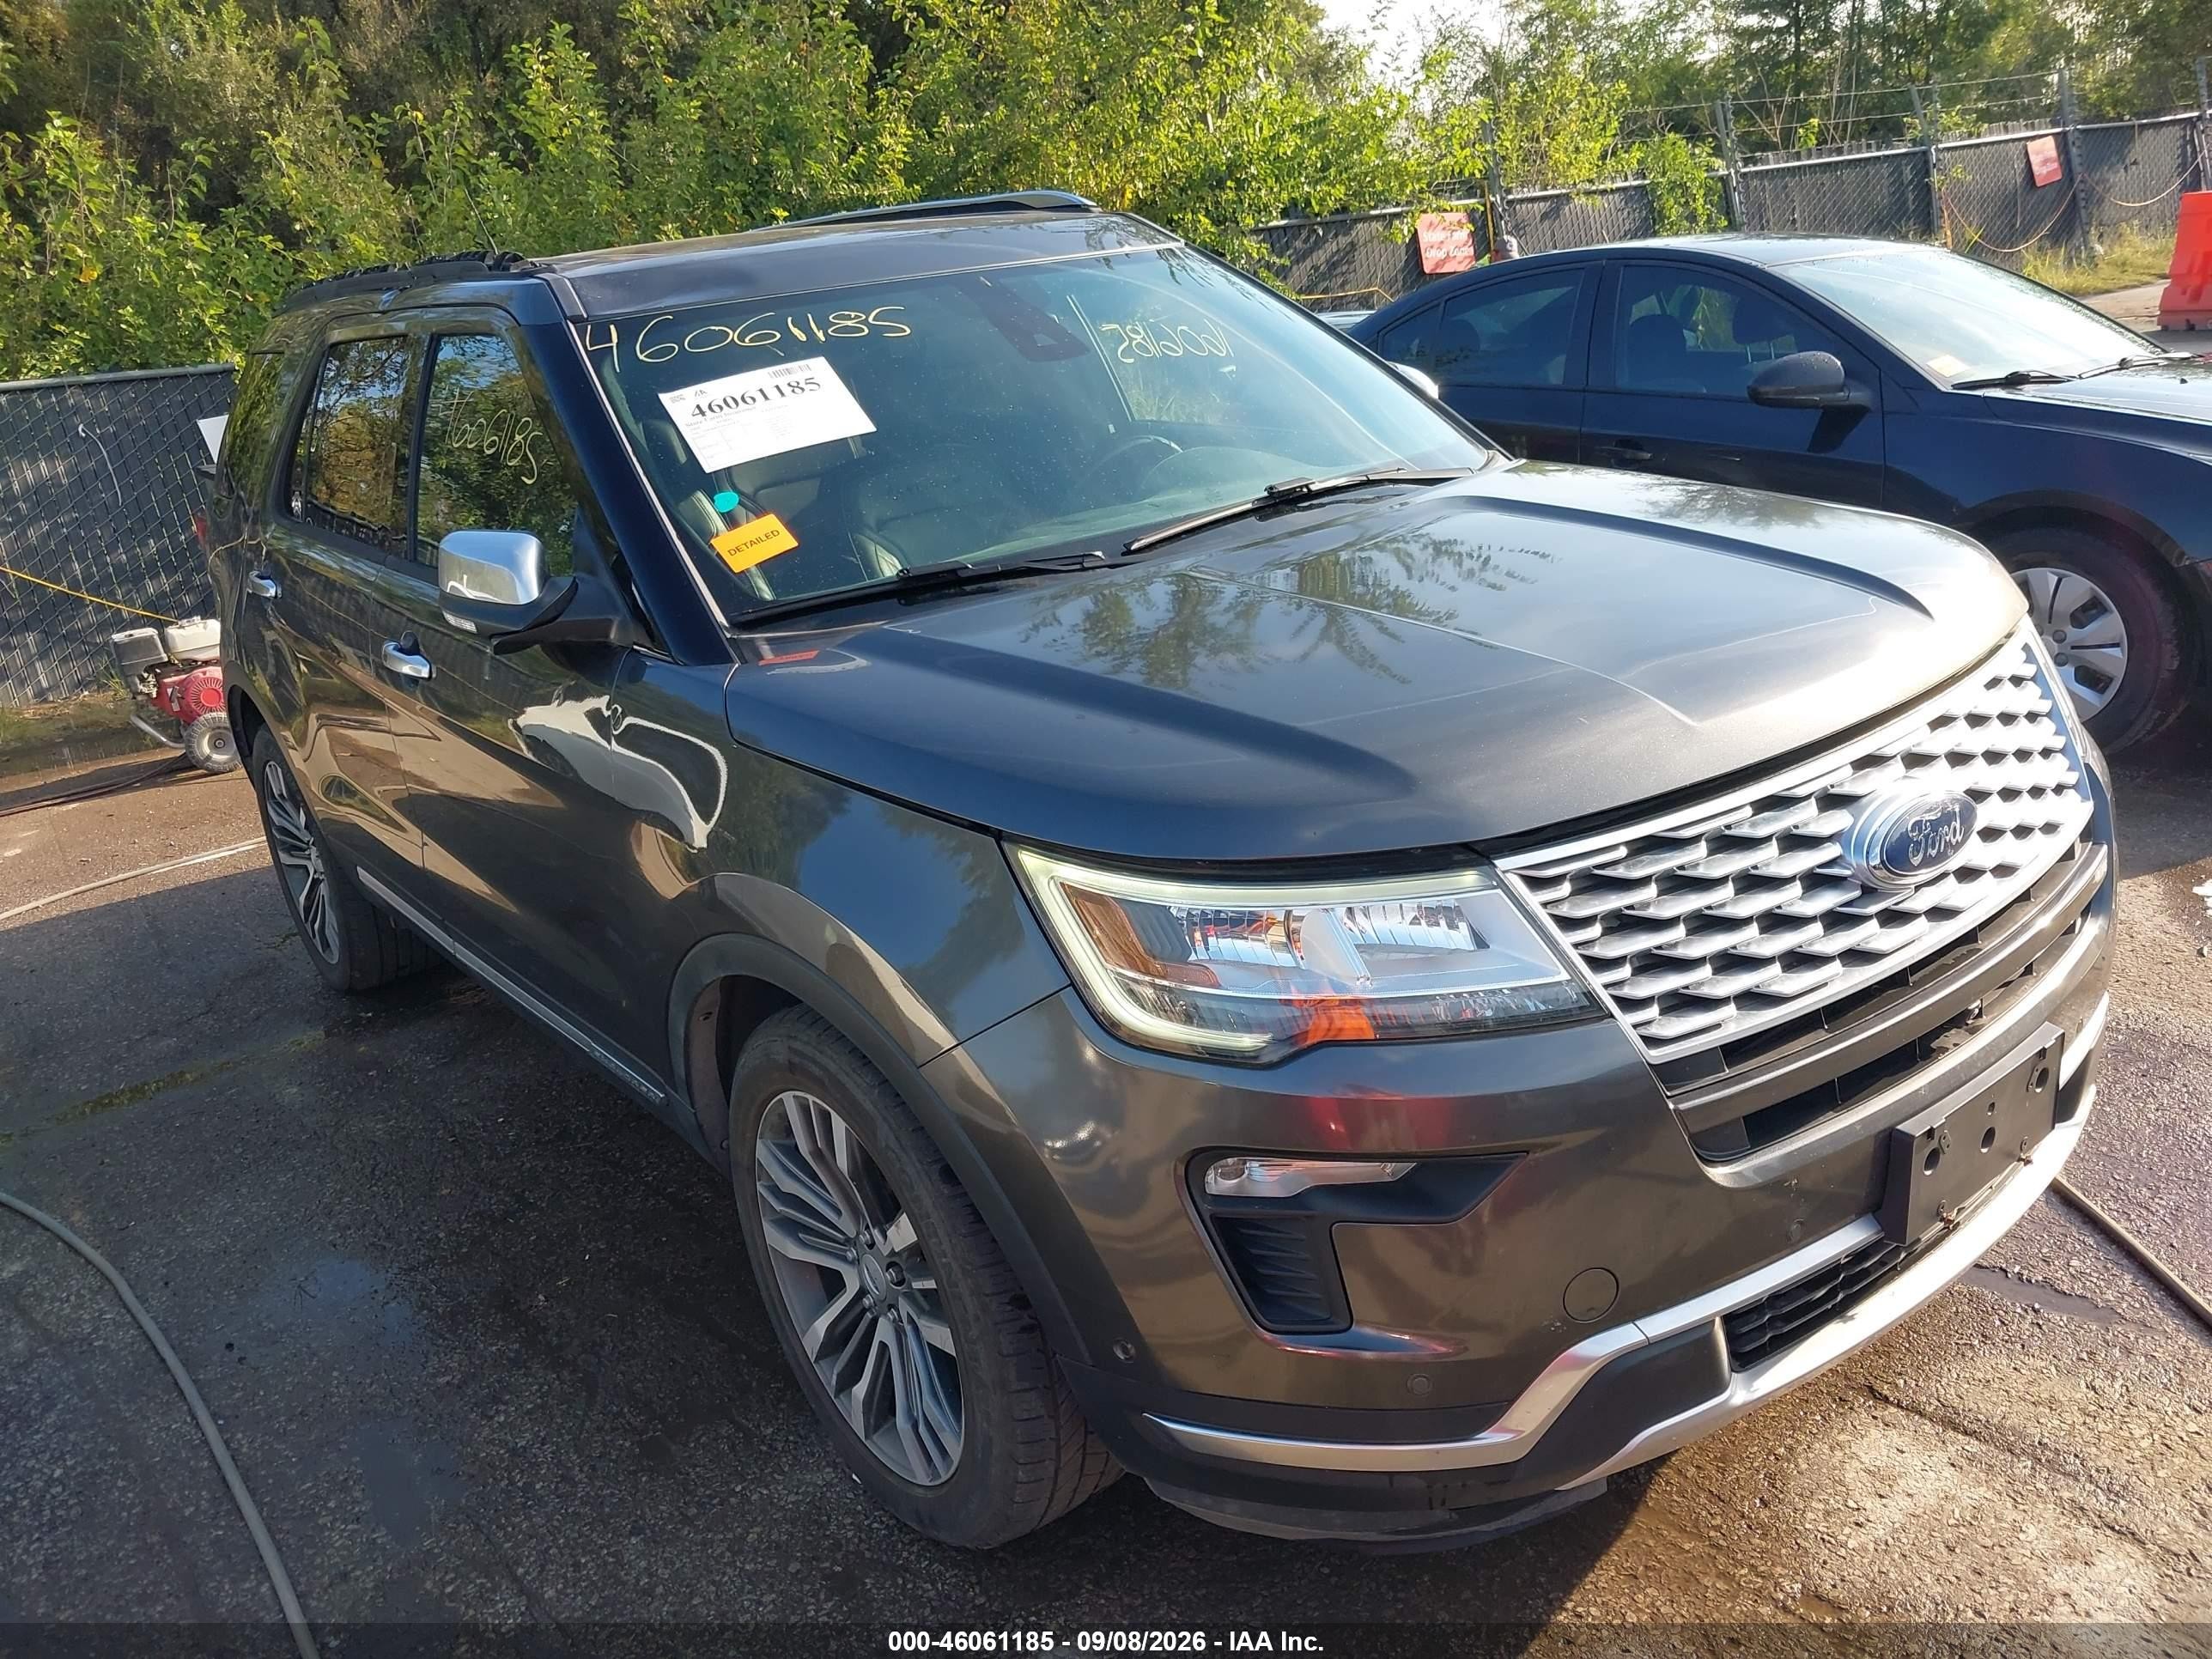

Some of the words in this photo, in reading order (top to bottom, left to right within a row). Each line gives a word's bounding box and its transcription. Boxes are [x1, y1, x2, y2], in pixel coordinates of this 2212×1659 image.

[1425, 246, 1447, 258] Drop
[586, 307, 911, 372] 46061185
[691, 377, 822, 419] 46061185
[727, 529, 781, 556] DETAILED
[1907, 801, 1966, 866] Ford
